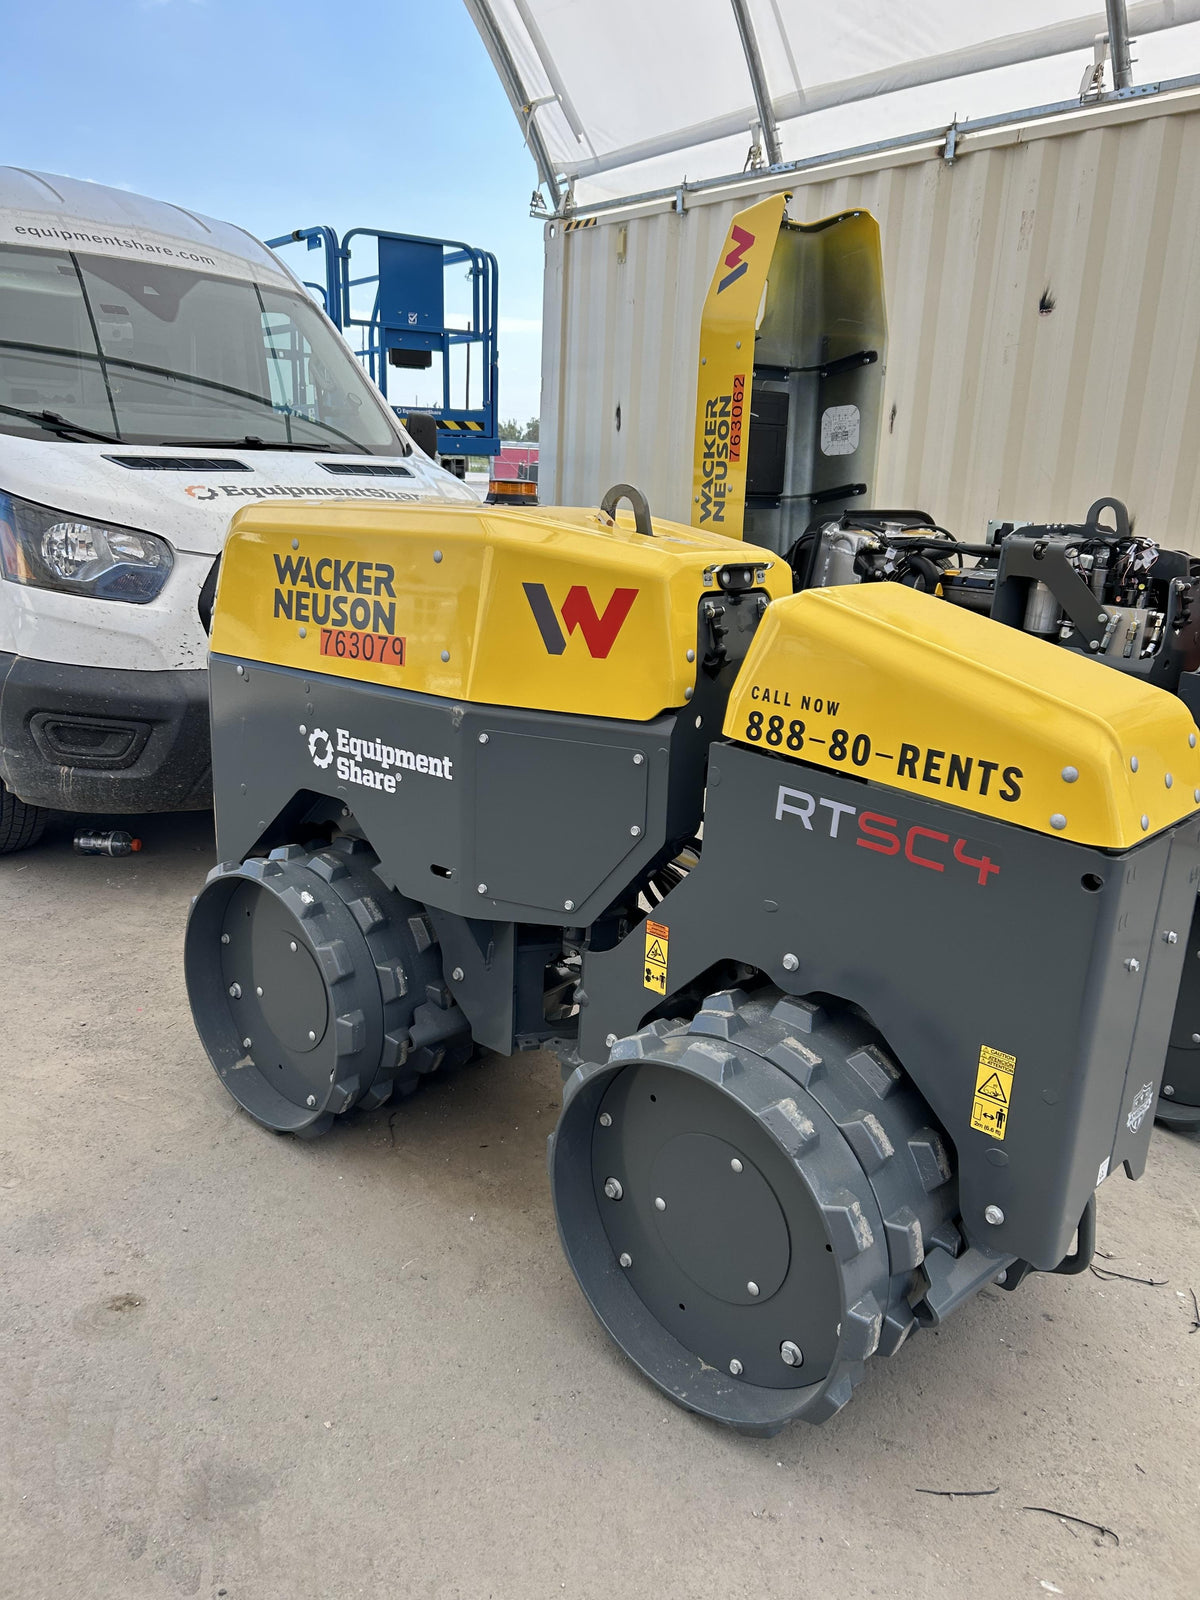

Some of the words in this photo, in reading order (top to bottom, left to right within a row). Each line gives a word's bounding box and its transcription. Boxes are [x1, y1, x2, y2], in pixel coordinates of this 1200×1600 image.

[14, 224, 216, 266] equipmentshare.com
[729, 376, 745, 461] 763062
[700, 396, 719, 524] WACKER
[712, 395, 732, 522] NEUSON
[218, 484, 421, 501] EquipmentShar
[273, 553, 397, 598] WACKER
[273, 588, 397, 636] NEUSON
[322, 628, 404, 666] 763079
[751, 686, 791, 707] CALL
[800, 695, 841, 716] NOW
[336, 728, 453, 780] Equipment
[745, 710, 1024, 803] 888-80-RENTS
[990, 1049, 1015, 1062] CAUTION
